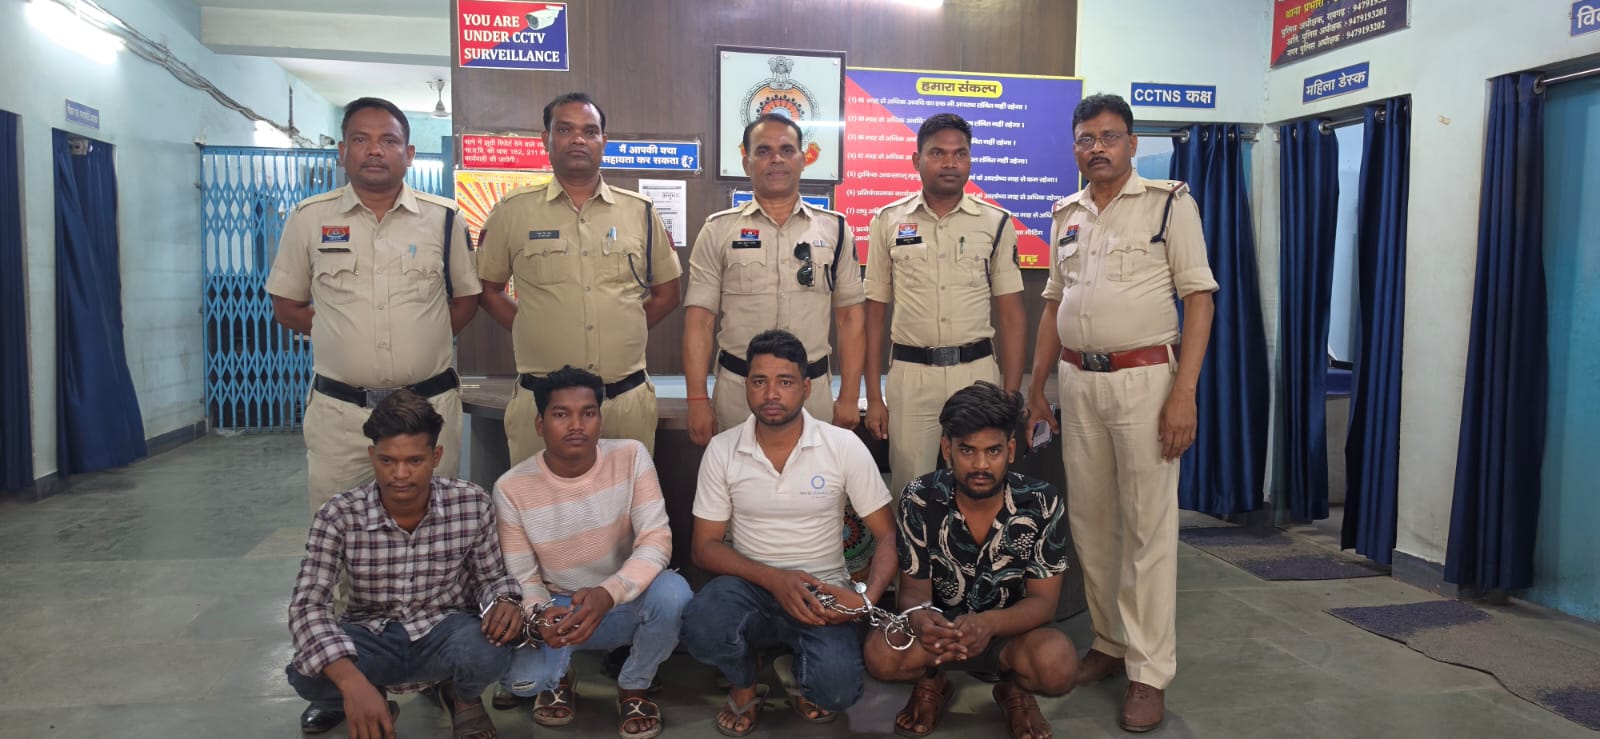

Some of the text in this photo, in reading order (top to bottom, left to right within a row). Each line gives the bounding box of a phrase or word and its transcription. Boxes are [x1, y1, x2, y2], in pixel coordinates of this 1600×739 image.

[463, 13, 520, 27] YOU ARE
[464, 29, 546, 44] UNDER CCTV
[464, 48, 560, 62] SURVEILLANCE
[920, 80, 997, 94] हमारा संकल्प
[1306, 71, 1366, 96] महिला डेस्क
[1134, 88, 1213, 104] CCTNS कक्ष
[619, 143, 677, 155] मैं आपकी क्या
[602, 155, 635, 165] सहायता
[636, 156, 651, 164] कर
[653, 156, 679, 165] सकता
